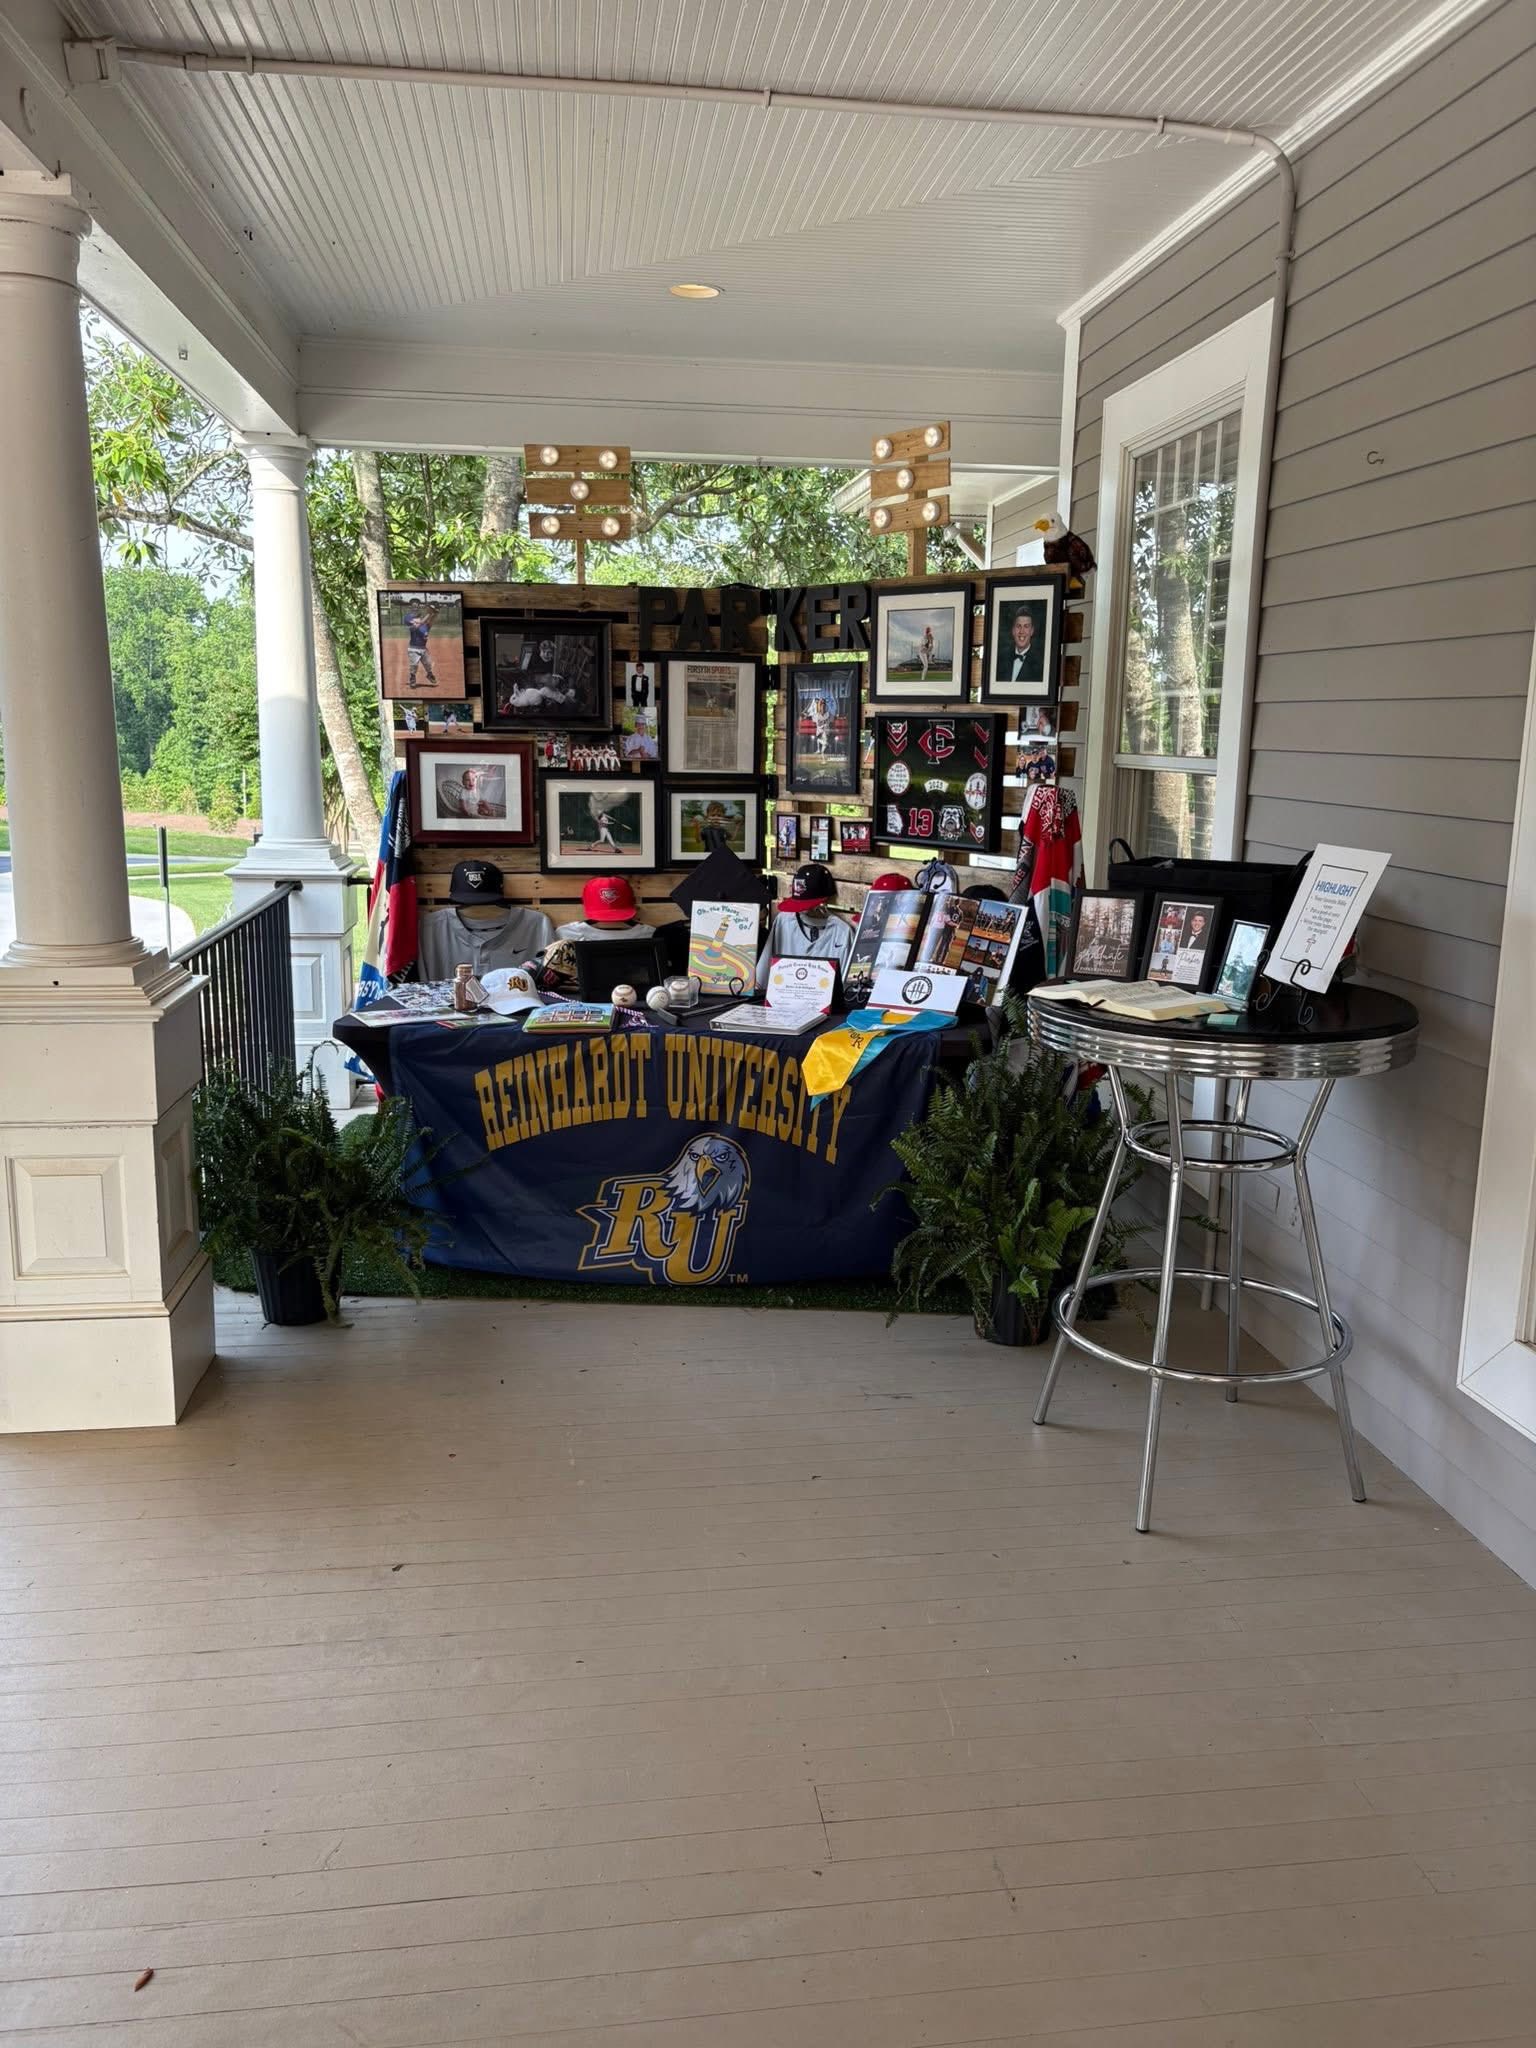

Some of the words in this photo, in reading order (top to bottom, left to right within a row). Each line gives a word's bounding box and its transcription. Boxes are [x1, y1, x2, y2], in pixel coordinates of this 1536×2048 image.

[639, 584, 874, 651] PARKER
[908, 808, 934, 837] 13
[468, 873, 483, 882] USA
[1315, 880, 1357, 897] HIGHLIGHT
[475, 1033, 651, 1152] REINHARDT
[595, 1175, 745, 1286] RU
[727, 1273, 749, 1284] TM
